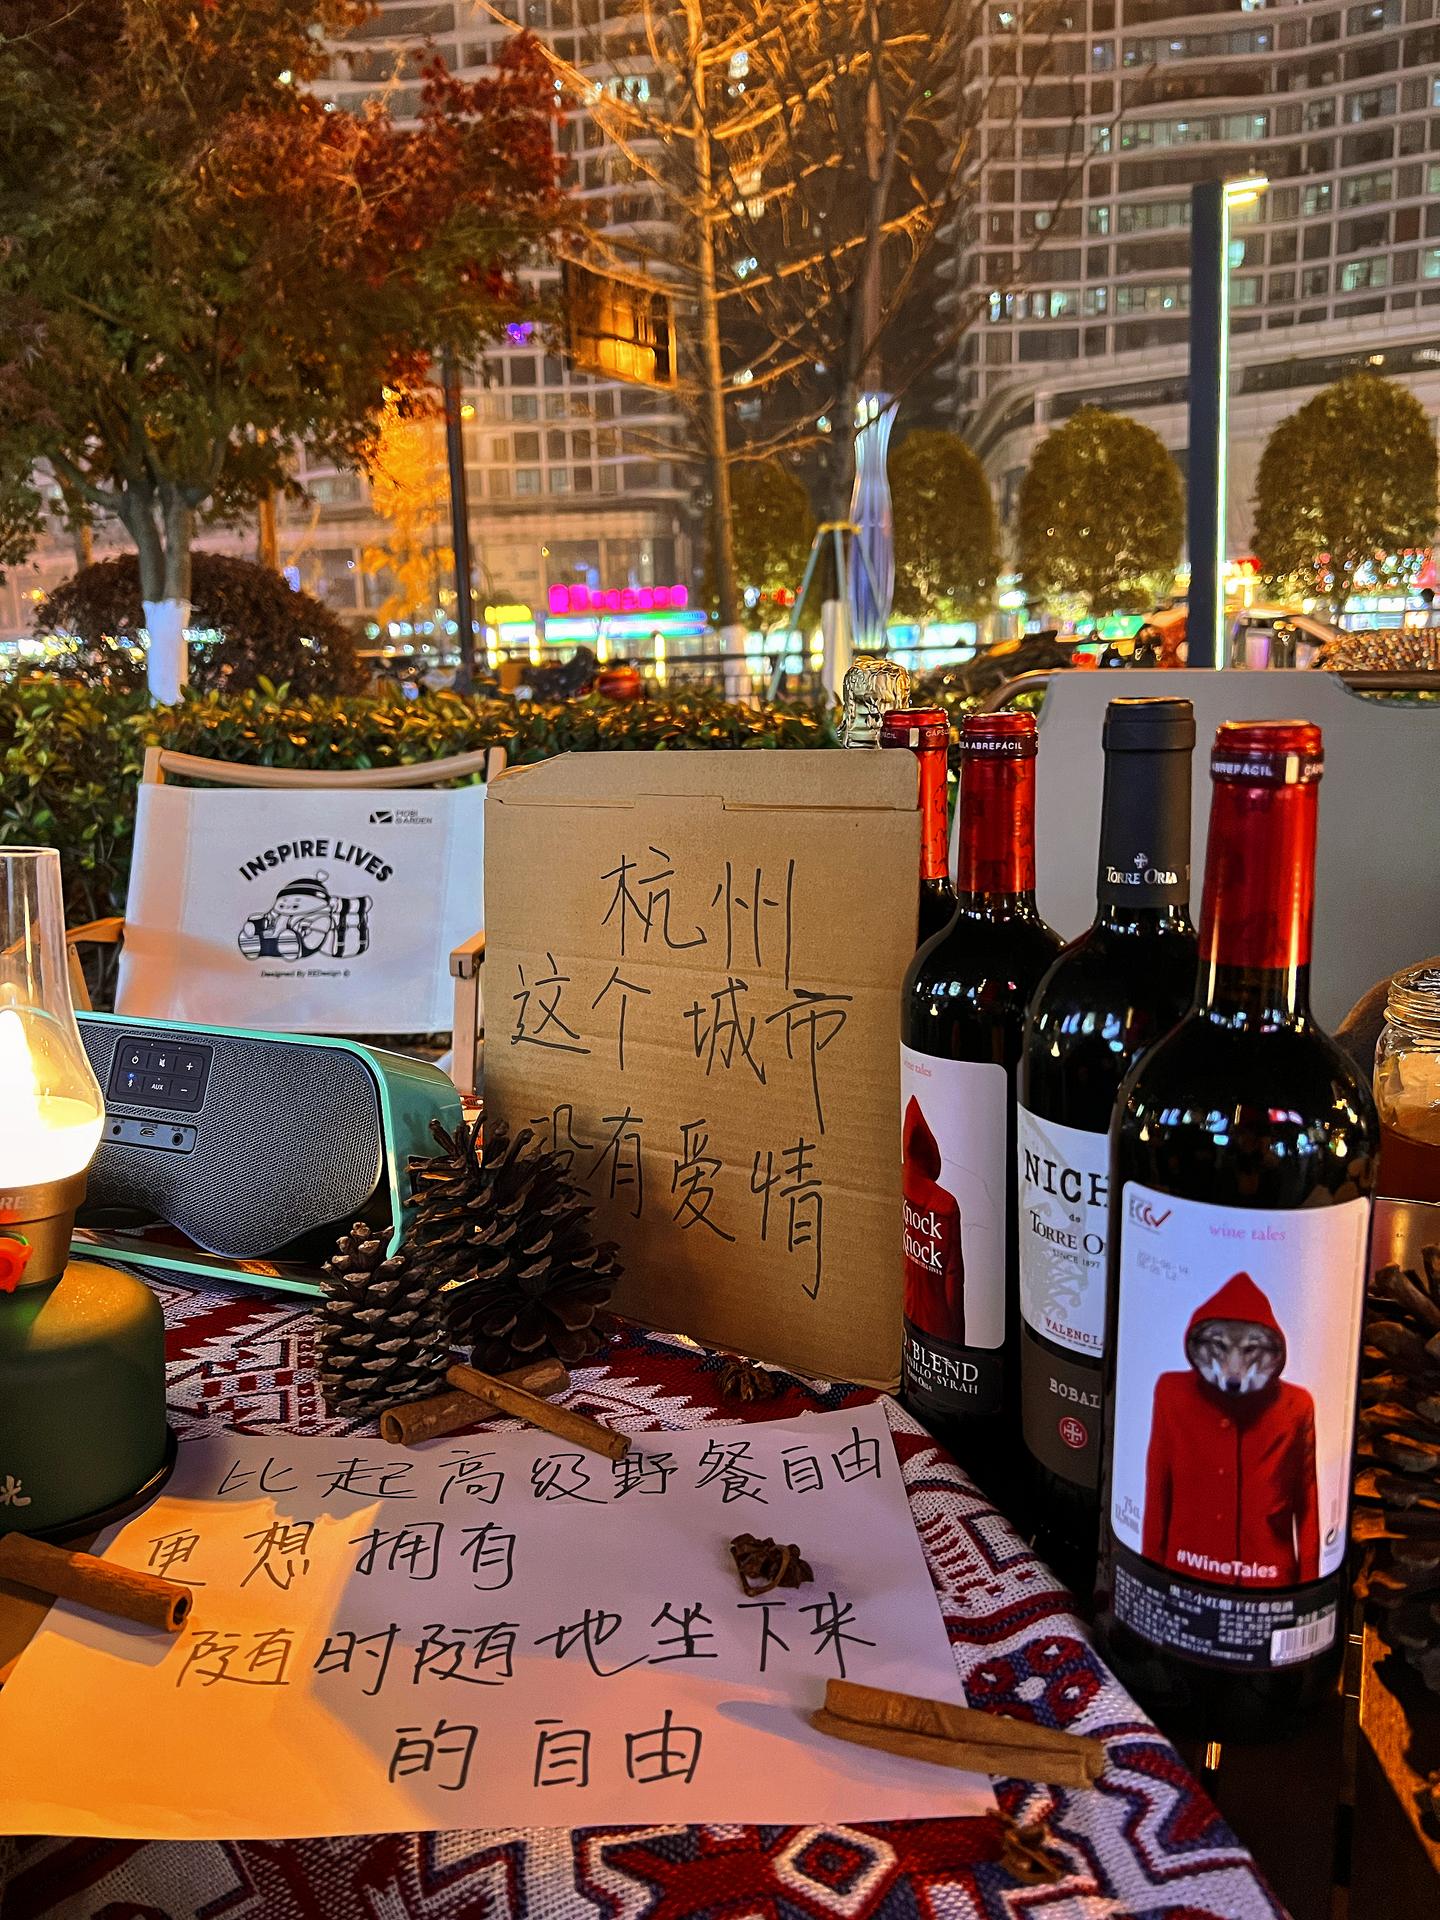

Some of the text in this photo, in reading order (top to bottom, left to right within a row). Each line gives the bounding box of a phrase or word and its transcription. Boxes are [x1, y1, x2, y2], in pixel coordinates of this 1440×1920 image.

[971, 741, 1023, 750] ABREFÁCIL
[239, 839, 394, 882] INSPIRE LIVES
[1106, 866, 1141, 885] TORRE
[600, 846, 796, 992] 杭州
[510, 952, 854, 1135] 这个城市
[151, 1083, 164, 1091] AUX
[1209, 1223, 1287, 1241] wine tales
[1045, 1318, 1104, 1346] VALENCI
[911, 1338, 979, 1383] BLEND
[936, 1375, 978, 1395] SYRAH
[217, 1426, 884, 1505] 比起高级野餐自由
[147, 1520, 517, 1592] 更想拥有
[1177, 1549, 1278, 1579] #WineTales
[176, 1591, 878, 1696] 随时随地坐下来
[388, 1710, 702, 1791] 的自由
